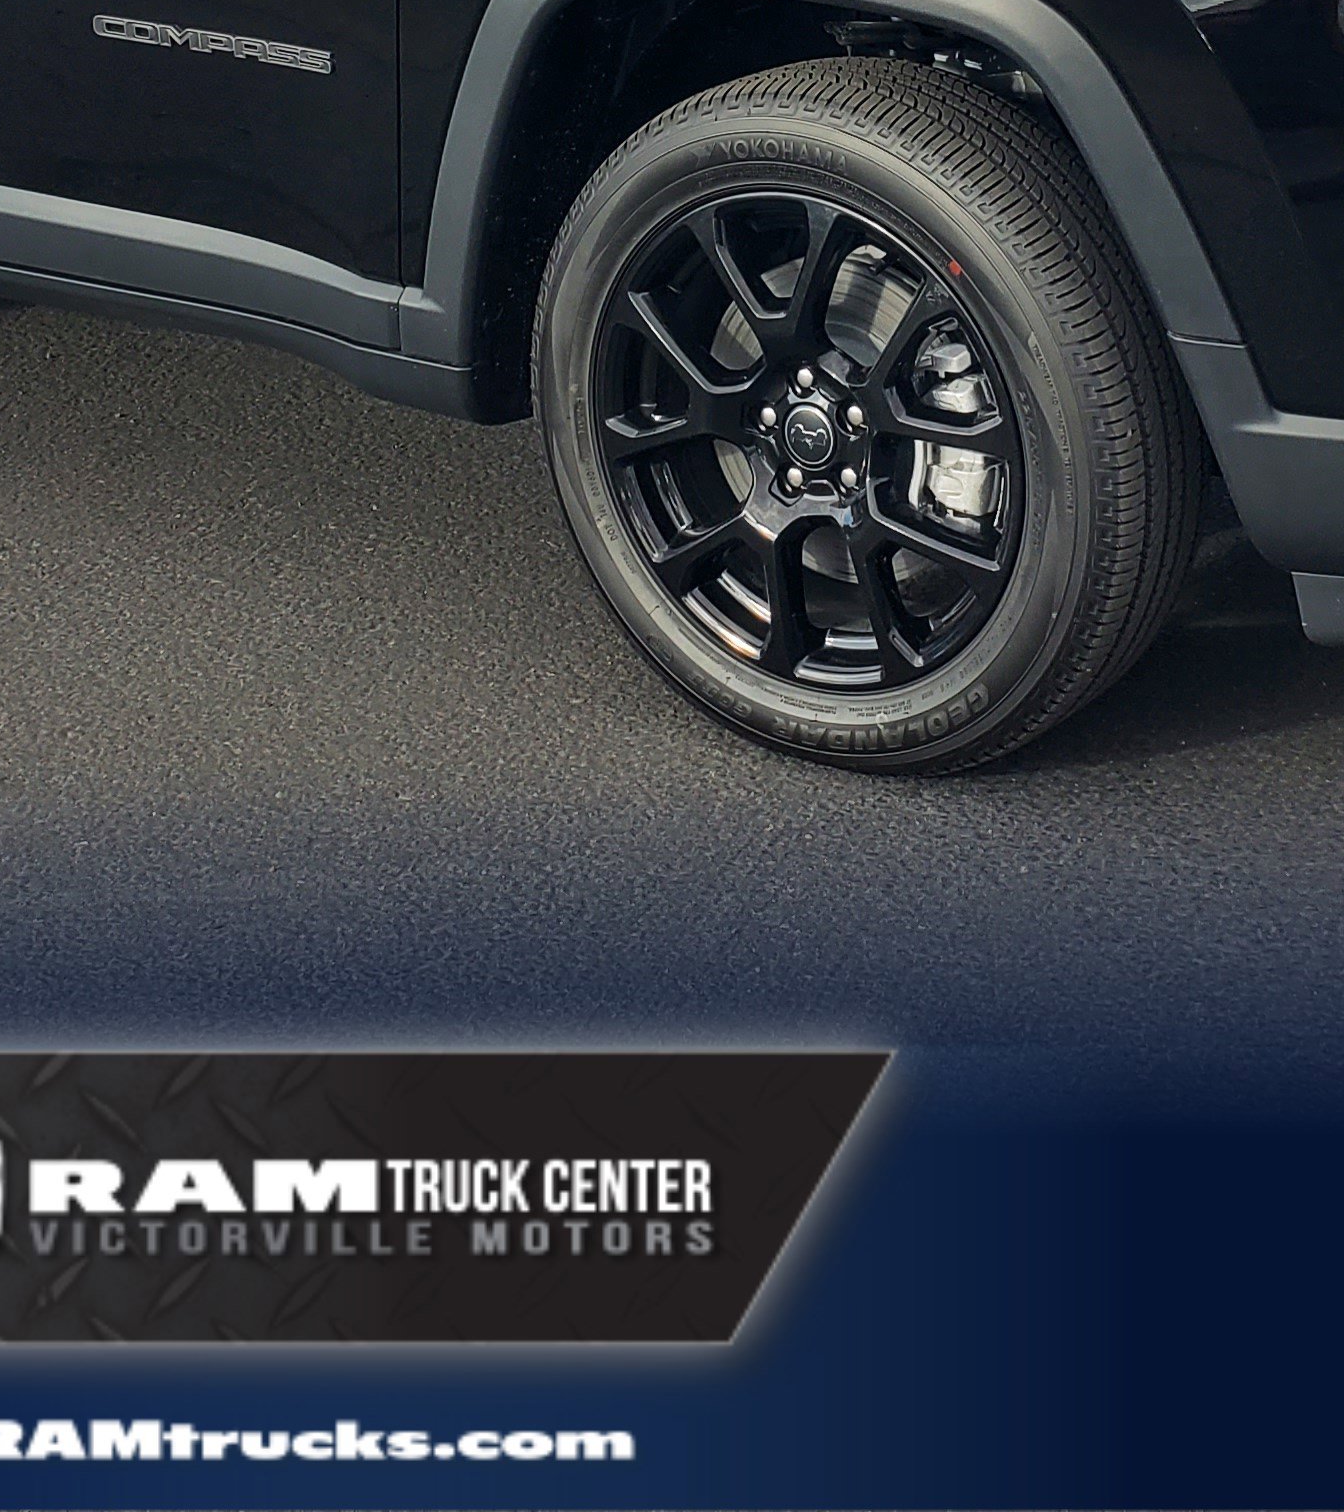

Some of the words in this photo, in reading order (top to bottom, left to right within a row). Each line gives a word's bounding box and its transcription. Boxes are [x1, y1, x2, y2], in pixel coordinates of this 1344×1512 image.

[92, 13, 336, 75] COMPASS
[719, 137, 849, 174] YOKOHAMA
[771, 682, 989, 751] GEOLANDAR
